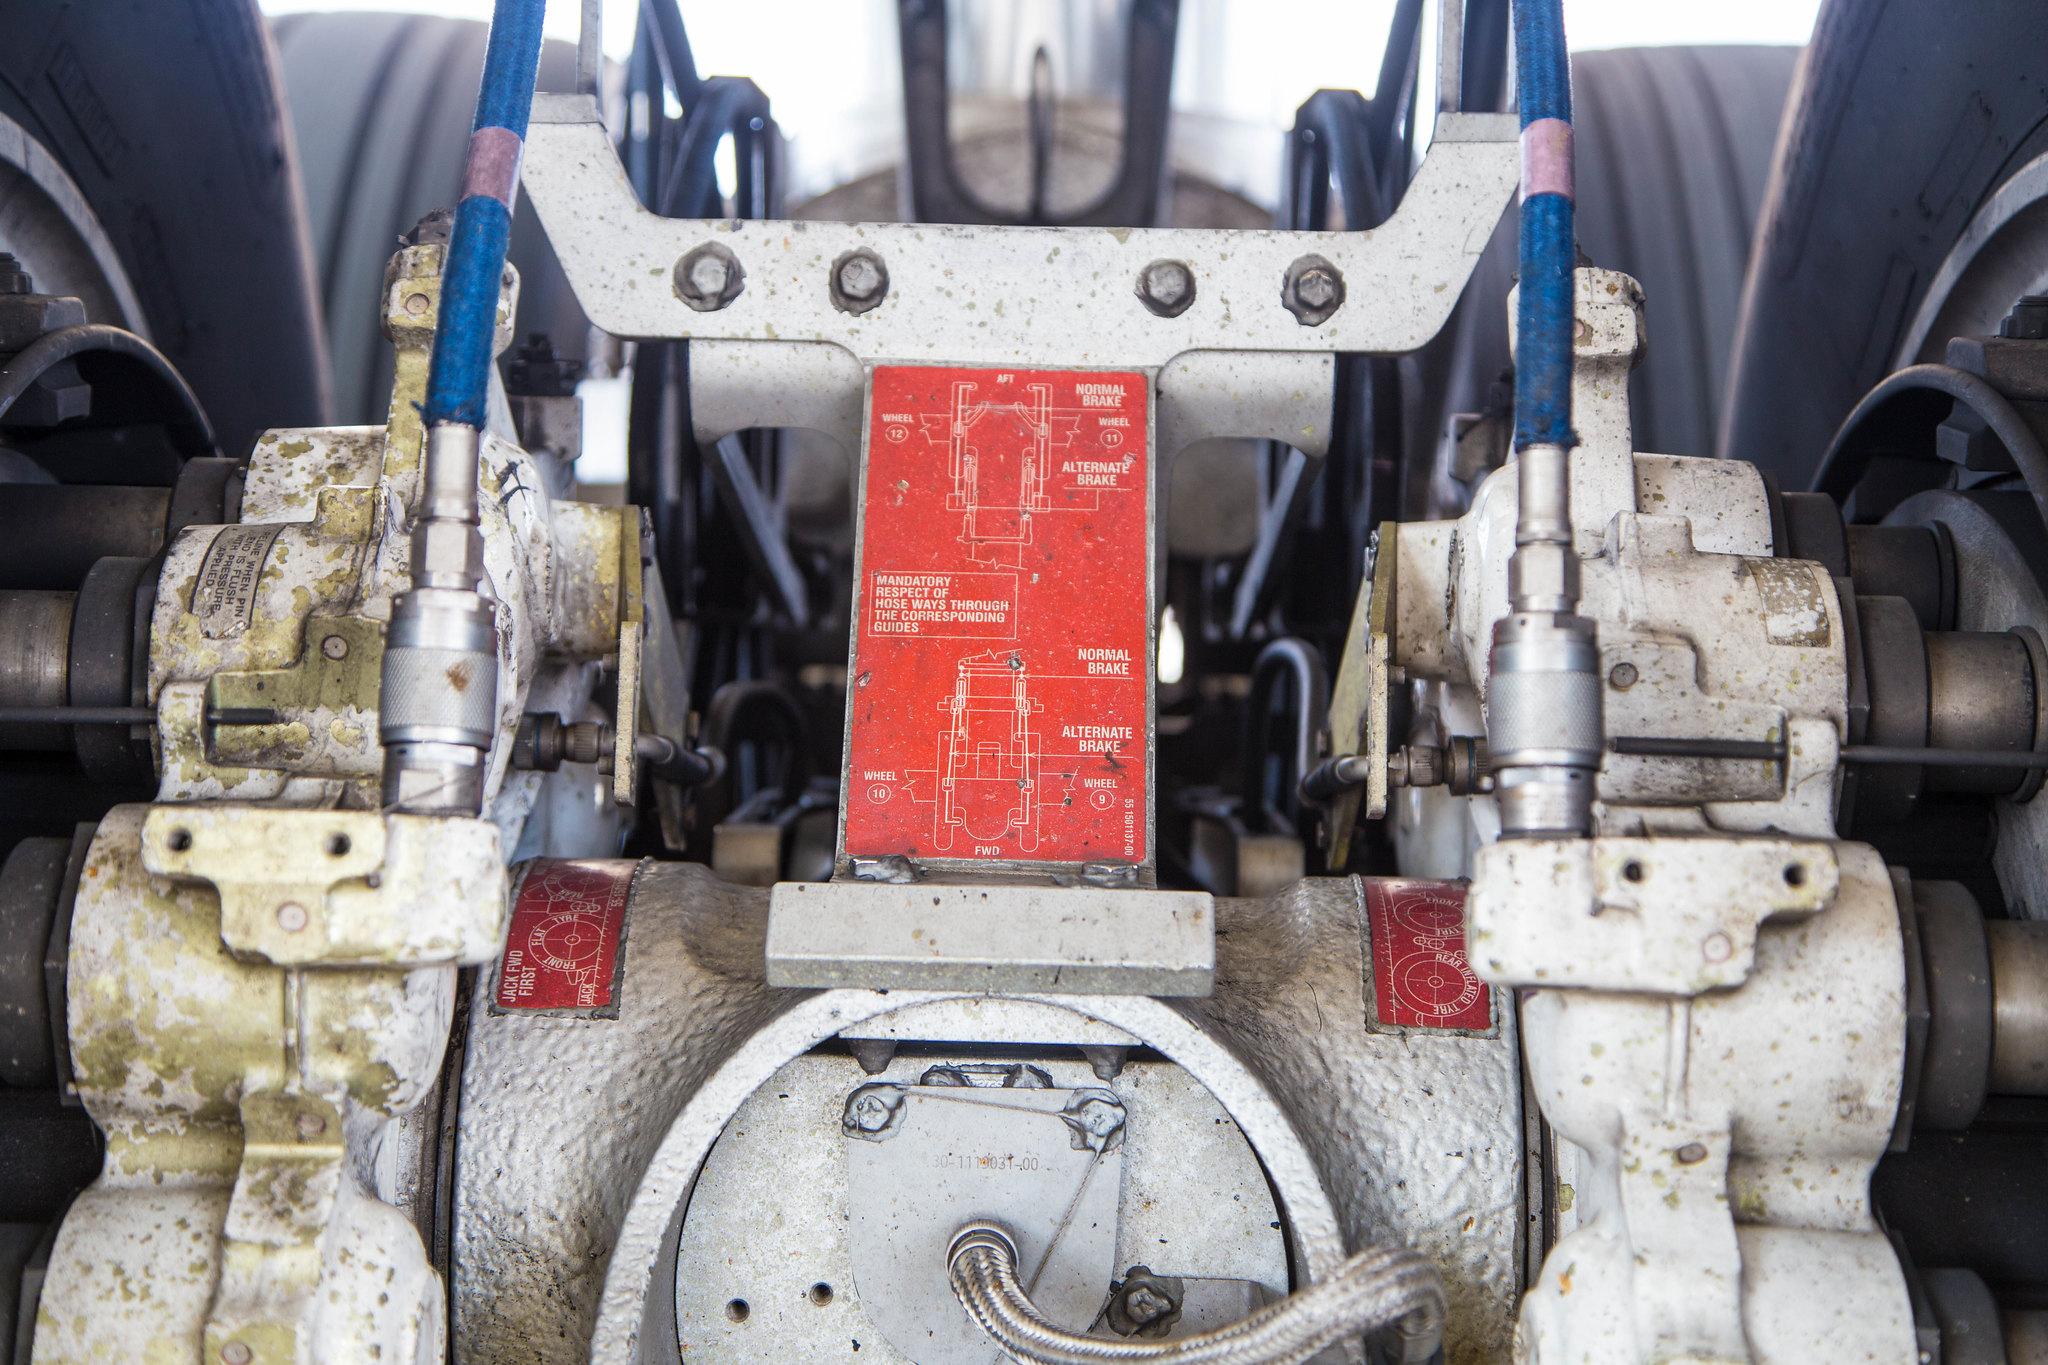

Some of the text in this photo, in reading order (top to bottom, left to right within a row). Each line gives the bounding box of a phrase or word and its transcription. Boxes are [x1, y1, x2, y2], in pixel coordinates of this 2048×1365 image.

[1075, 384, 1127, 396] NORMAL
[1082, 395, 1122, 407] BRAKE
[882, 413, 914, 423] WHEEL
[1098, 417, 1130, 427] WHEEL
[891, 428, 903, 438] 12
[1106, 433, 1118, 443] 11
[1062, 461, 1130, 474] ALTERNATE
[1077, 473, 1117, 486] BRAKE
[205, 545, 227, 587] APPLIED
[236, 556, 245, 564] IS
[240, 560, 257, 592] WHEN
[876, 576, 951, 587] MANDATORY
[212, 554, 235, 612] PRESSURE
[225, 569, 242, 605] FLUSH
[876, 587, 949, 598] RESPECT OF
[234, 598, 246, 618] PIN
[875, 599, 1009, 611] HOSE WAYS THROUGH
[875, 611, 1005, 623] THE CORRESPONDING
[874, 622, 919, 633] GUIDES
[1078, 648, 1132, 662] NORMAL
[1087, 662, 1129, 675] BRAKE
[1062, 726, 1132, 739] ALTERNATE
[1079, 739, 1121, 752] BRAKE
[864, 771, 897, 781] WHEEL
[1084, 779, 1118, 789] WHEEL
[872, 789, 886, 799] 10
[1099, 794, 1106, 804] 9
[1125, 798, 1134, 810] 55
[975, 846, 1000, 856] FWD
[552, 914, 580, 924] TYRE
[531, 928, 546, 947] FLAT
[542, 956, 576, 970] FRONT
[502, 950, 524, 1002] JACK FWD
[518, 966, 537, 996] FIRST
[1433, 953, 1478, 1015] REAR INFLATED TYRE
[581, 983, 593, 1005] JACK
